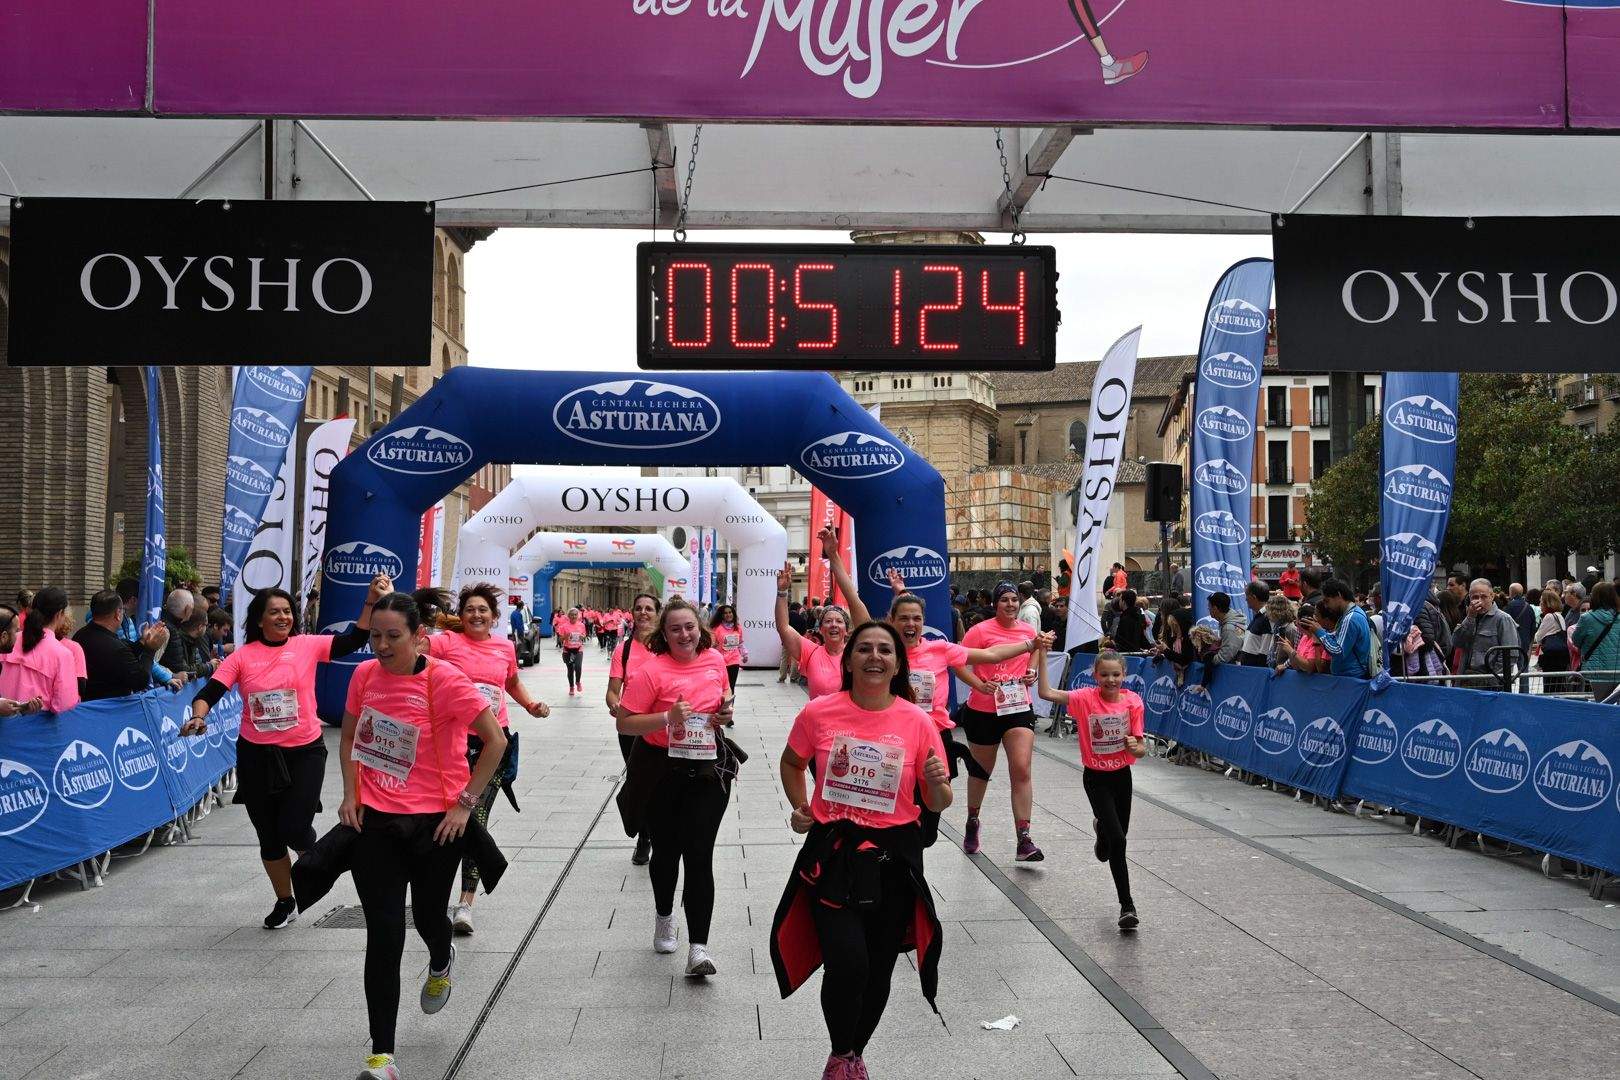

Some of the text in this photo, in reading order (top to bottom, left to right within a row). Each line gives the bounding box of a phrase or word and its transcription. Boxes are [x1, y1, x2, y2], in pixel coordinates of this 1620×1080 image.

[80, 253, 373, 315] OYSHO
[1341, 269, 1618, 325] OYSHO
[1205, 362, 1253, 382] ASTURIANA
[592, 399, 704, 409] CENTRAL LECHERA
[566, 400, 709, 431] ASTURIANA
[1200, 414, 1246, 436] ASTURIANA
[1393, 407, 1455, 437] ASTURIANA
[373, 442, 464, 464] ASTURIANA
[810, 450, 899, 467] ASTURIANA
[227, 468, 272, 493] STURIANA
[561, 486, 690, 513] OYSHO
[483, 514, 523, 525] OYSHO
[725, 514, 764, 525] OYSHO
[326, 556, 397, 576] ASTURIANA
[463, 567, 502, 577] OYSHO
[687, 730, 704, 738] 016
[1357, 733, 1393, 754] TURIANA
[1404, 736, 1456, 767] ASTURIANA
[117, 752, 158, 778] ASTURIANA
[850, 764, 876, 778] 016
[1467, 748, 1524, 781] ASTURIANA
[61, 767, 111, 797] ASTURIANA
[853, 777, 869, 787] 3176
[1537, 760, 1606, 798] ASTURIANA
[0, 786, 44, 816] RIANA
